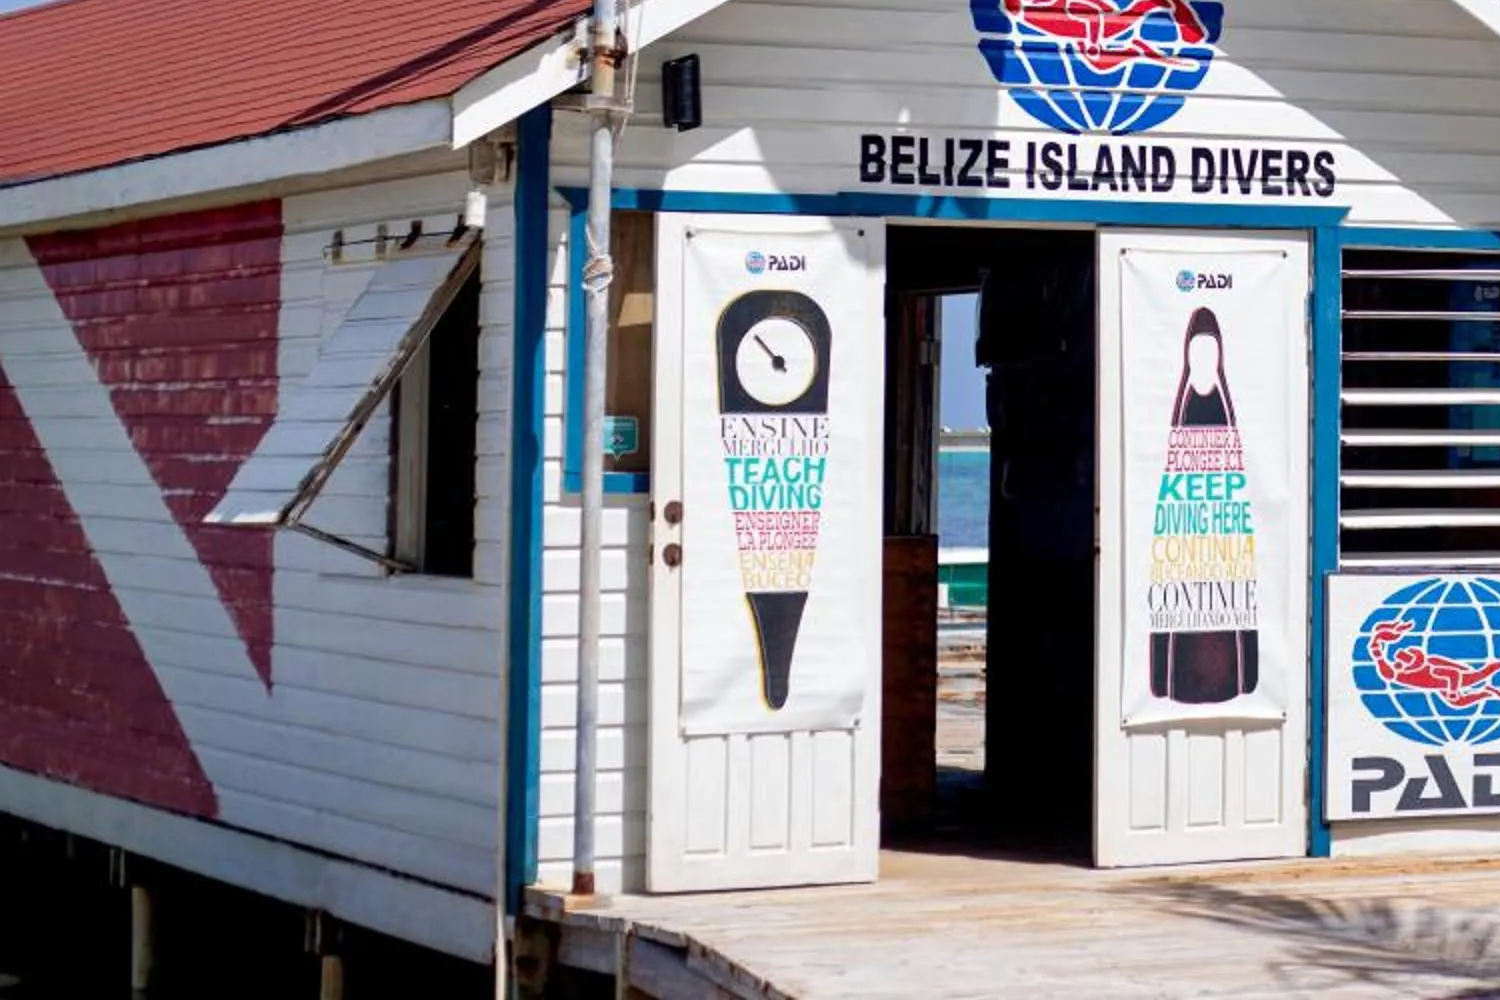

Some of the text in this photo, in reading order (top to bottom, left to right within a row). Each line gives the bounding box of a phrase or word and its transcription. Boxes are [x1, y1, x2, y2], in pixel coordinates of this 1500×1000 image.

[859, 134, 1335, 198] BELIZE ISLAND DIVERS
[767, 255, 807, 271] PADI
[1197, 273, 1233, 289] PADI
[721, 417, 830, 439] ENSINE
[724, 457, 827, 484] TEACH
[728, 485, 823, 511] DIVING
[1157, 473, 1247, 501] KEEP
[1154, 502, 1254, 536] DIVING HERE
[1147, 581, 1258, 612] CONTINUE
